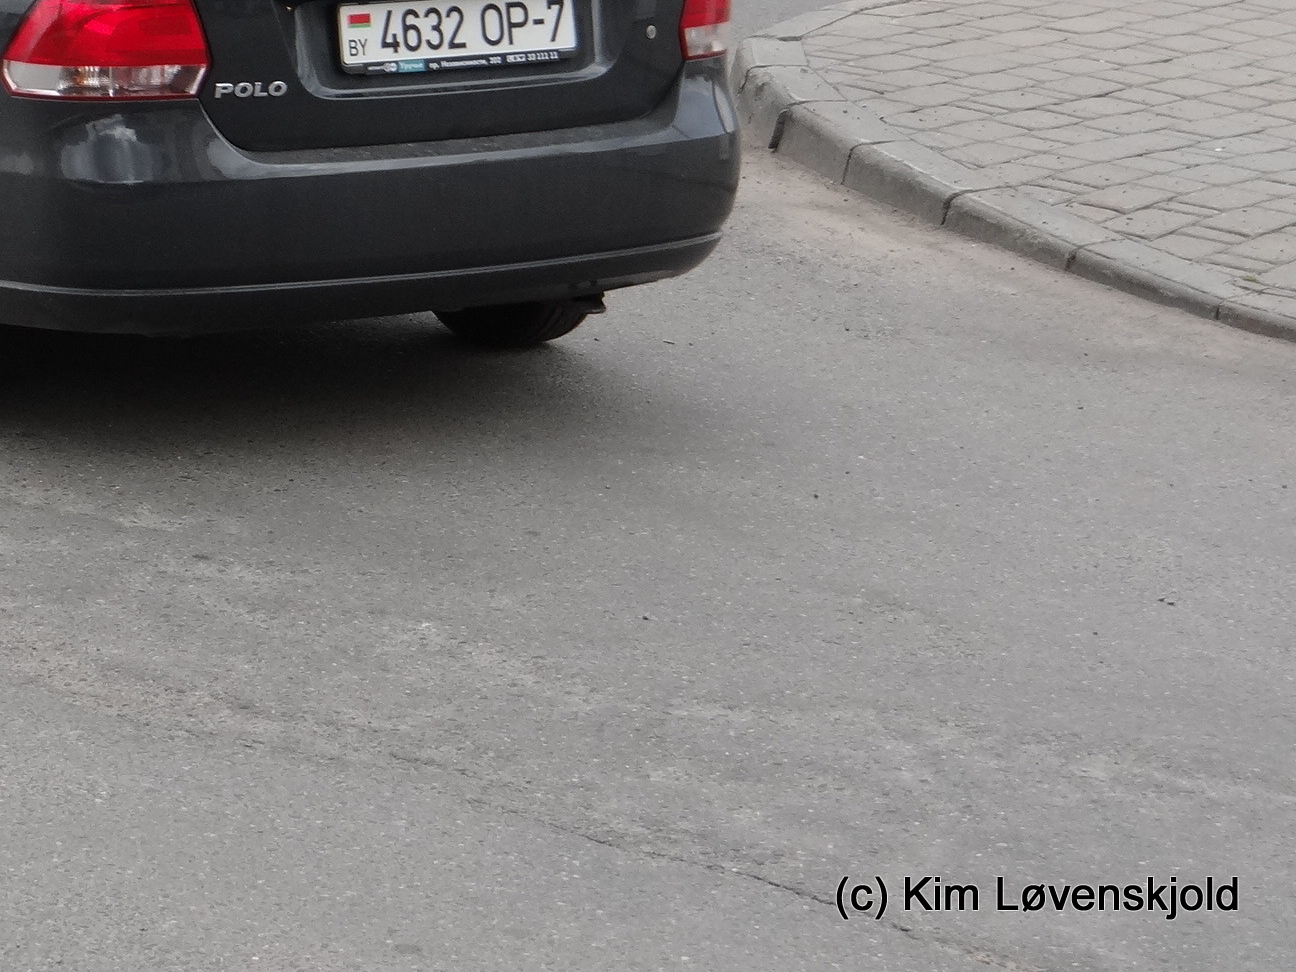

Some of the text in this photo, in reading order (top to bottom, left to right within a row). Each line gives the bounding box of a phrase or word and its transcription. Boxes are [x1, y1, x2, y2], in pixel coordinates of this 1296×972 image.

[380, 5, 467, 54] 4632
[348, 38, 368, 57] BY
[214, 80, 288, 99] POLO
